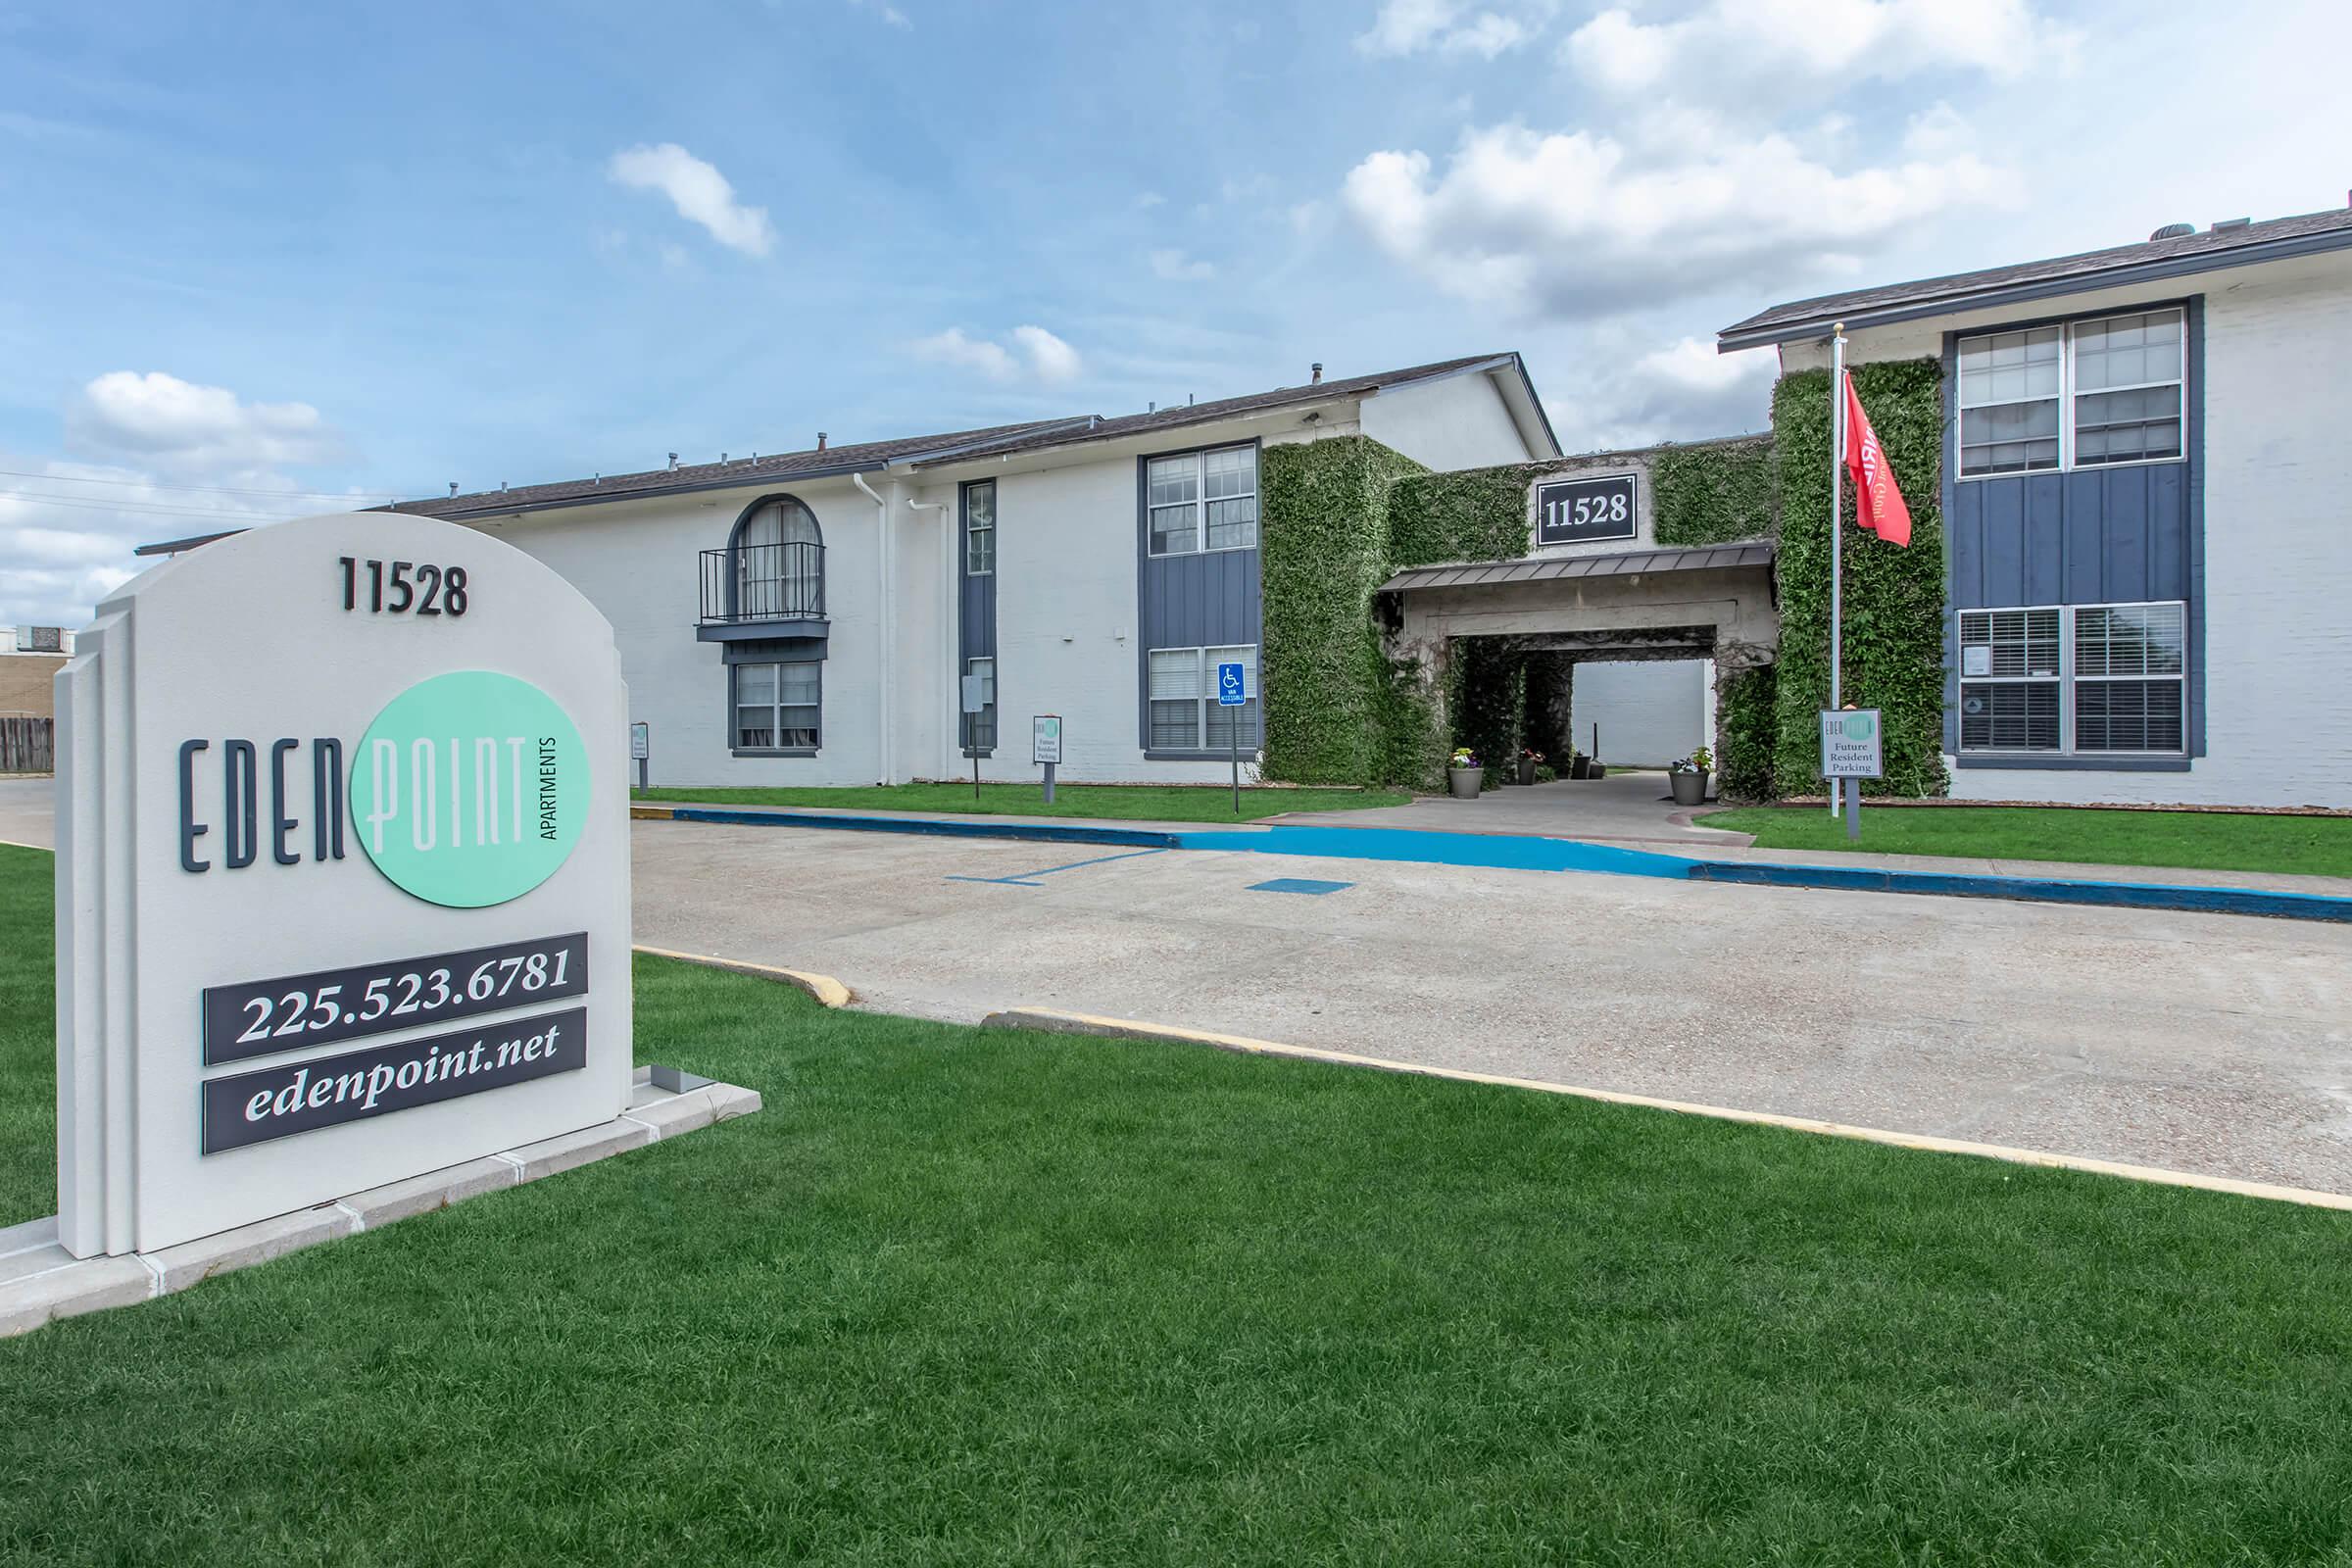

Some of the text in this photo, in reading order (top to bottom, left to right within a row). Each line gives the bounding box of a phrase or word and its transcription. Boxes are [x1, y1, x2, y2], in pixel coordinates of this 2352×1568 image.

[1545, 494, 1627, 527] 11528
[339, 556, 468, 616] 11528
[1831, 752, 1873, 761] Resident
[1833, 762, 1872, 773] Parking
[1835, 742, 1868, 751] Future
[179, 736, 526, 873] EDEN POINT
[540, 736, 557, 841] APARTMENTS
[236, 948, 569, 1044] 225.523.6781
[244, 1024, 561, 1122] edenpoint.net
